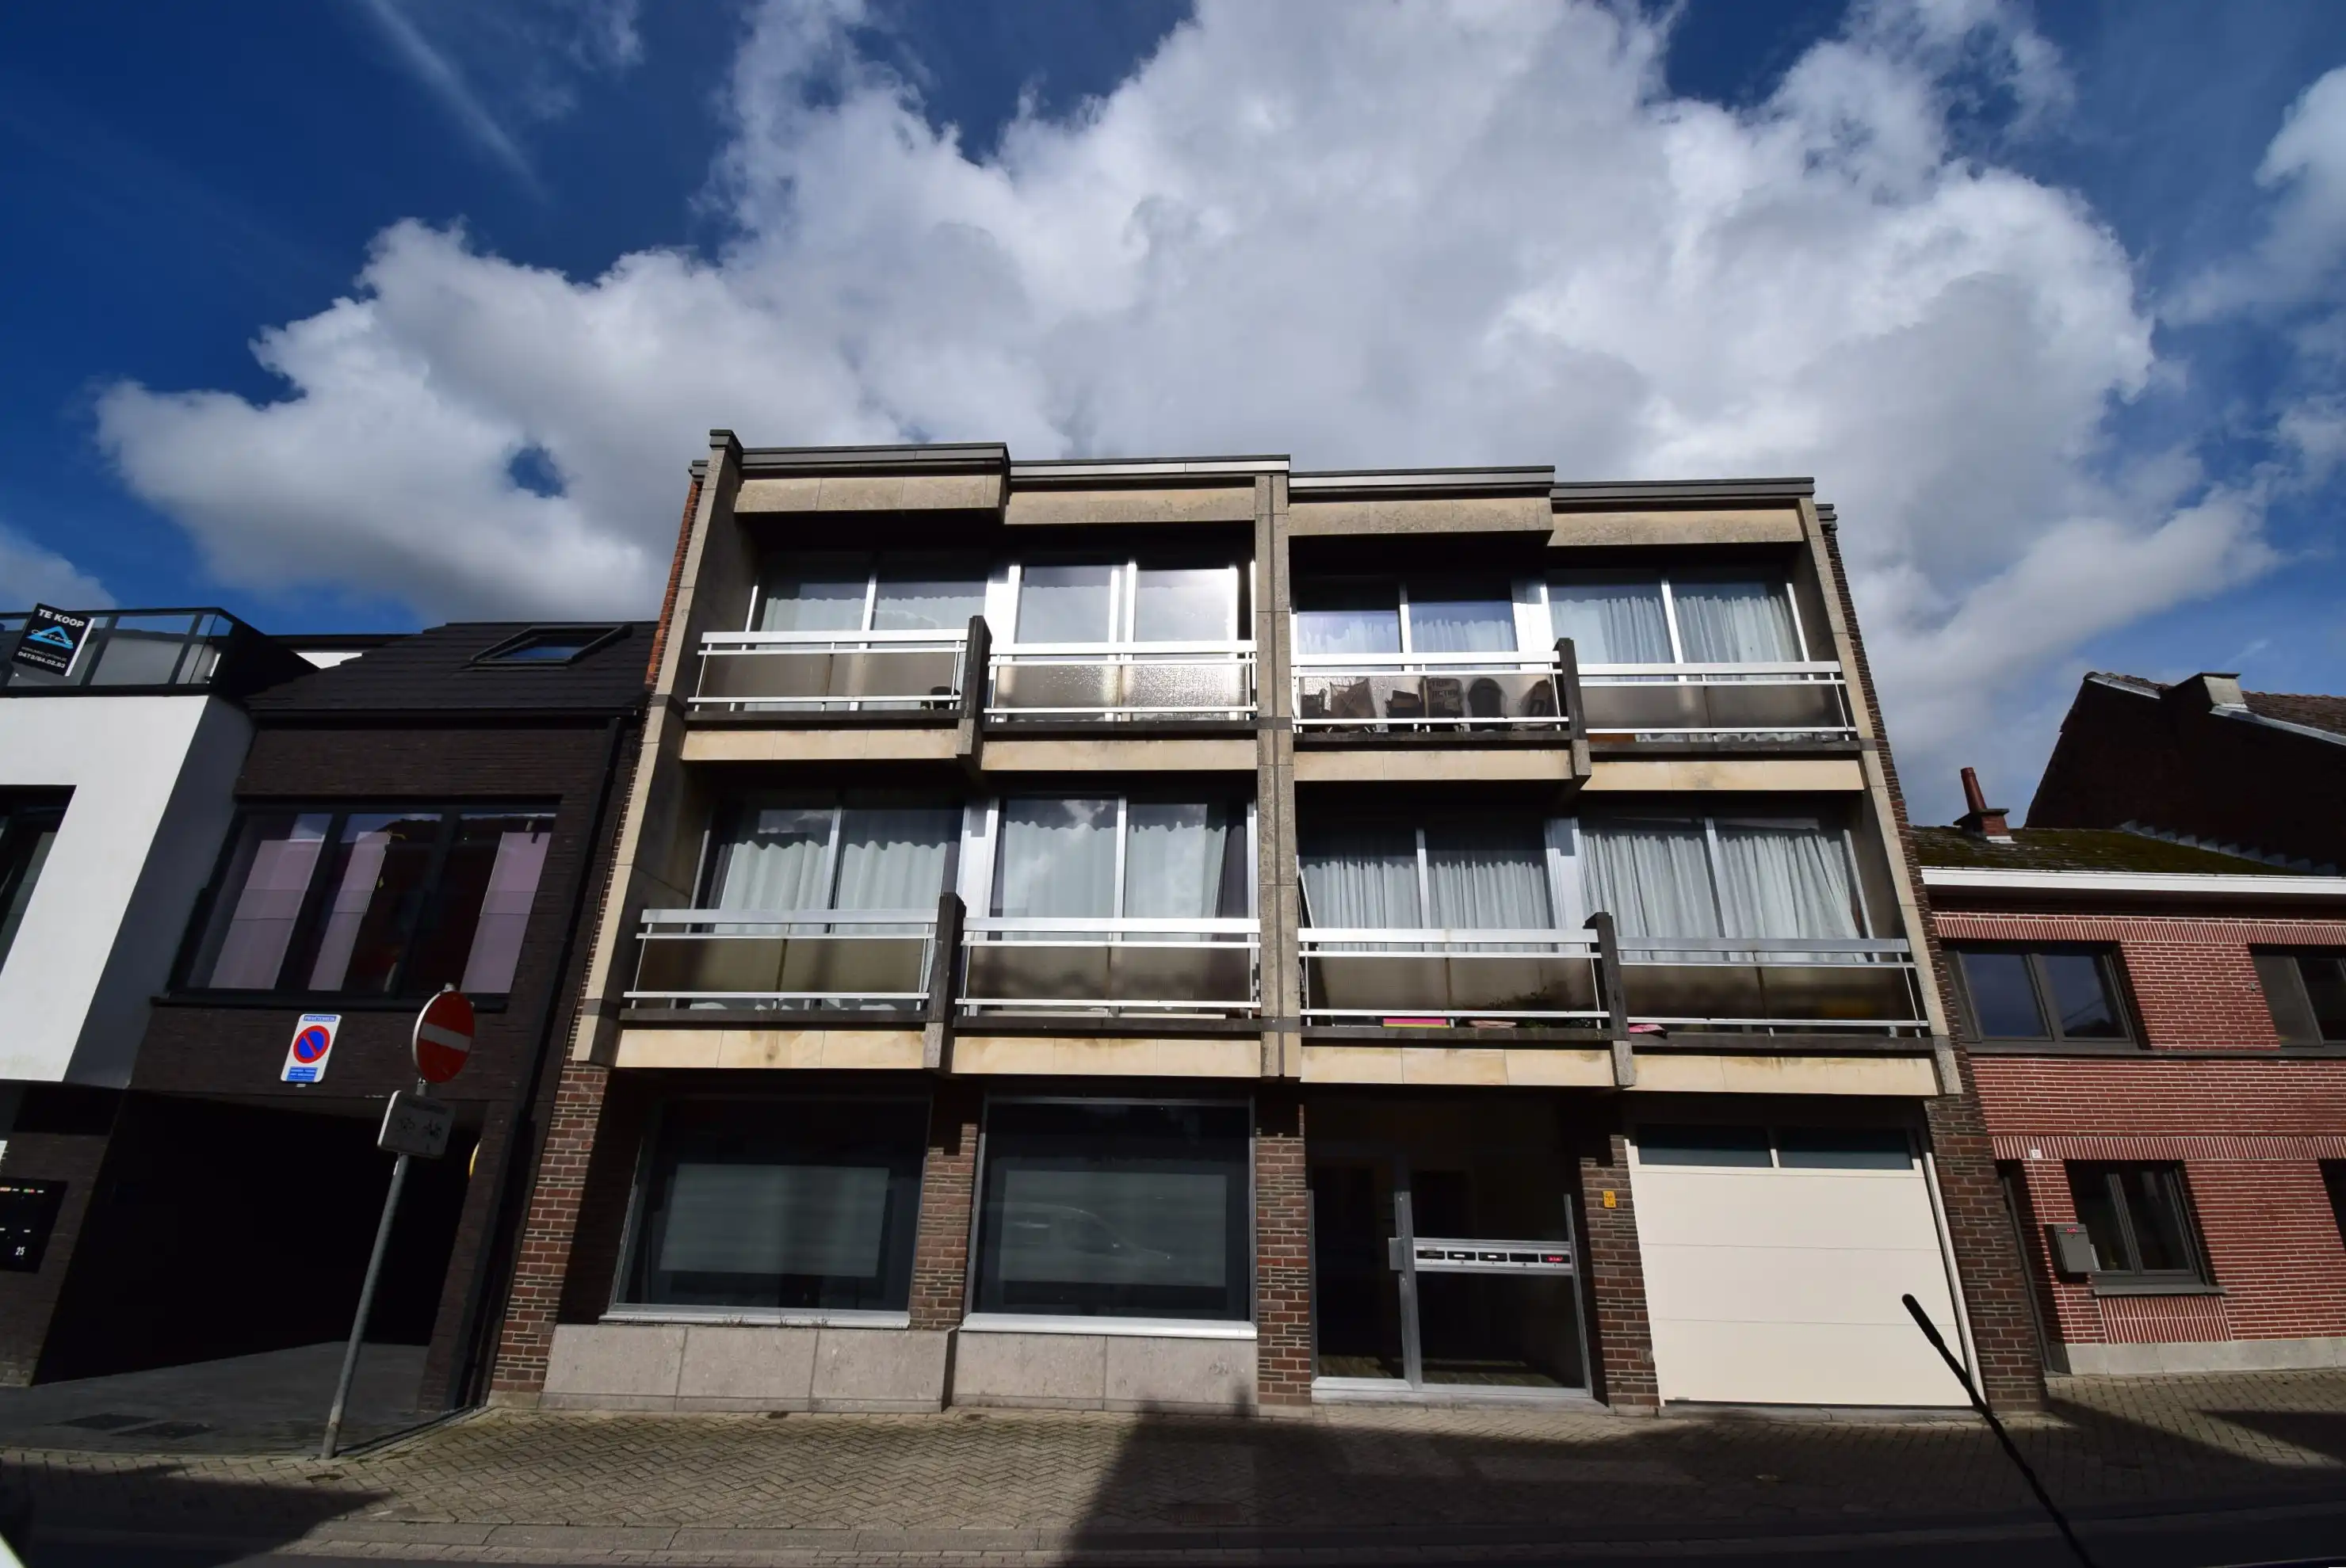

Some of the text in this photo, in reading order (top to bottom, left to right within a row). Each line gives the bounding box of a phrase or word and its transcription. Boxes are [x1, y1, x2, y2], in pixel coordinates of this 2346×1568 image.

[38, 609, 85, 628] TE KOOP
[15, 1246, 25, 1256] 25
